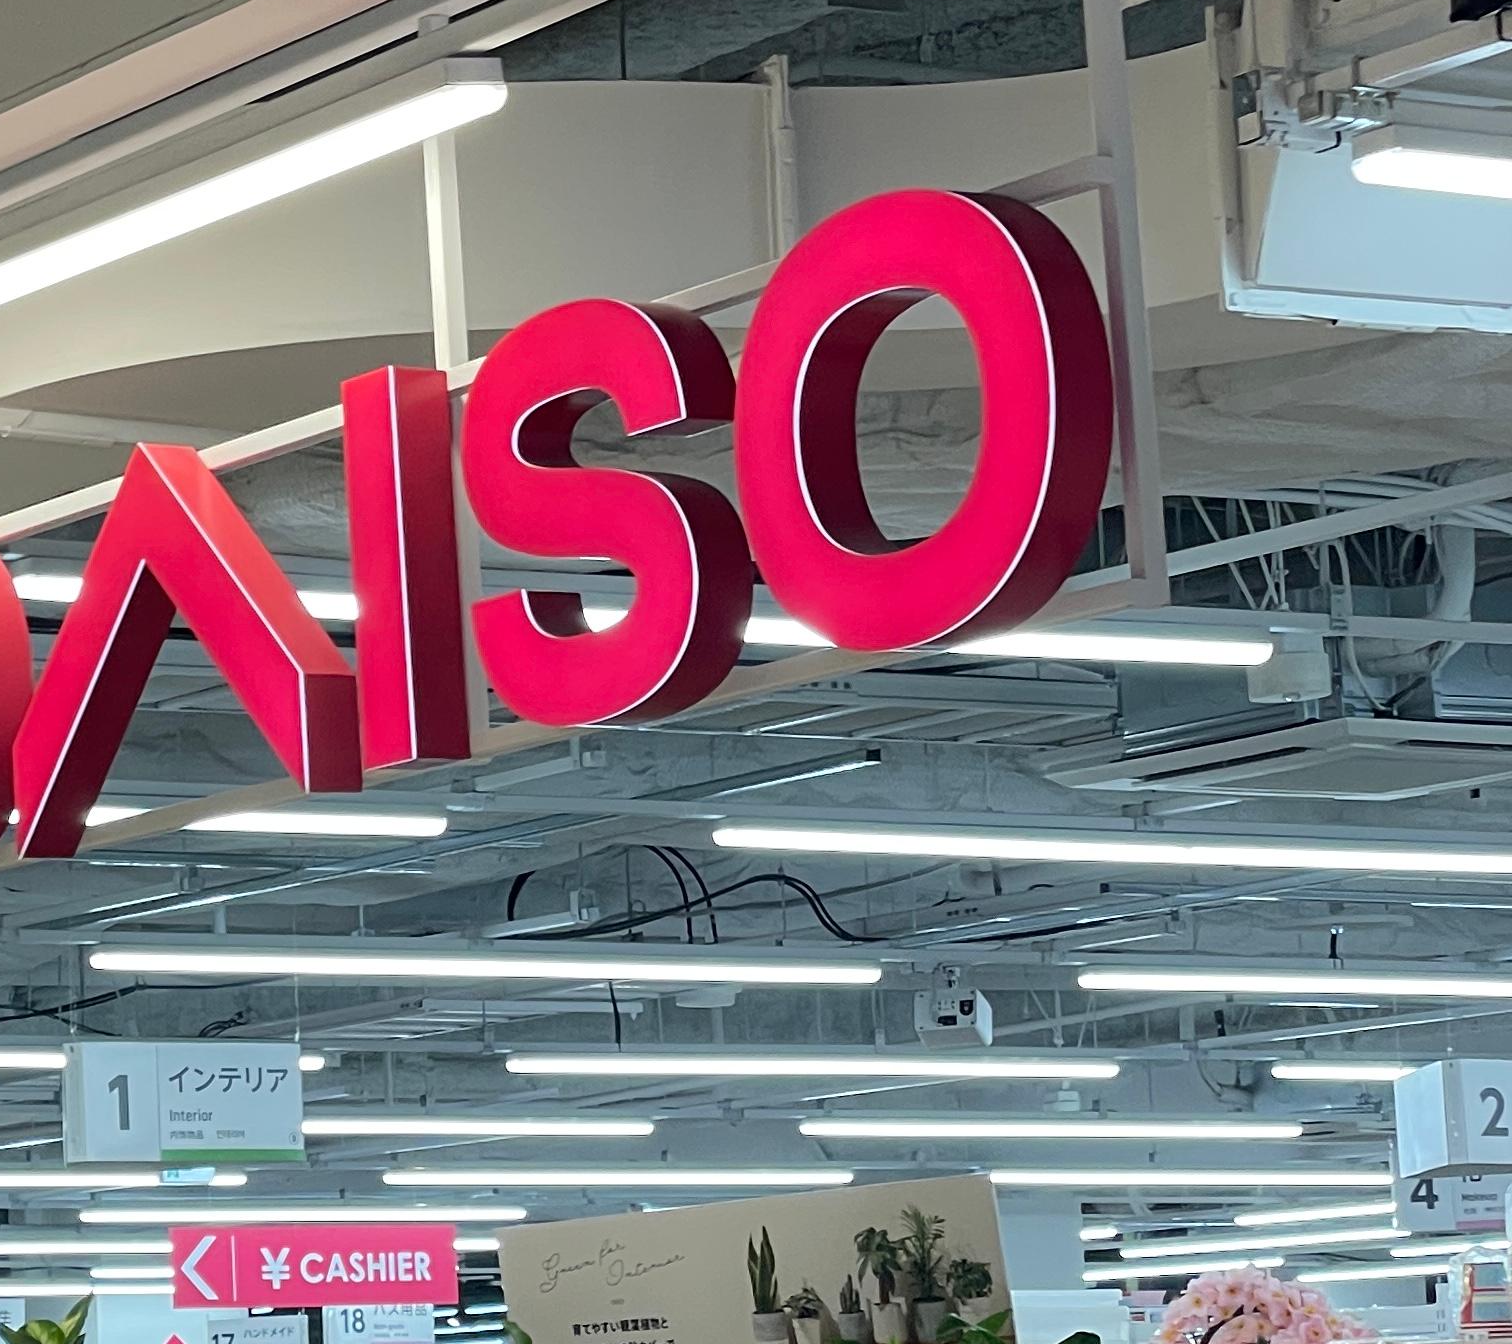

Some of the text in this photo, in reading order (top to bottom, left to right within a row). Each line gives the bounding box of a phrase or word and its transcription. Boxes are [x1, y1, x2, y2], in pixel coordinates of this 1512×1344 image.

[168, 1066, 289, 1093] インテリア
[108, 1074, 130, 1131] 1
[169, 1109, 213, 1122] Interior
[1479, 1087, 1510, 1137] 2
[1410, 1178, 1439, 1210] 4
[299, 1251, 432, 1284] CASHIER
[340, 1308, 366, 1334] 18
